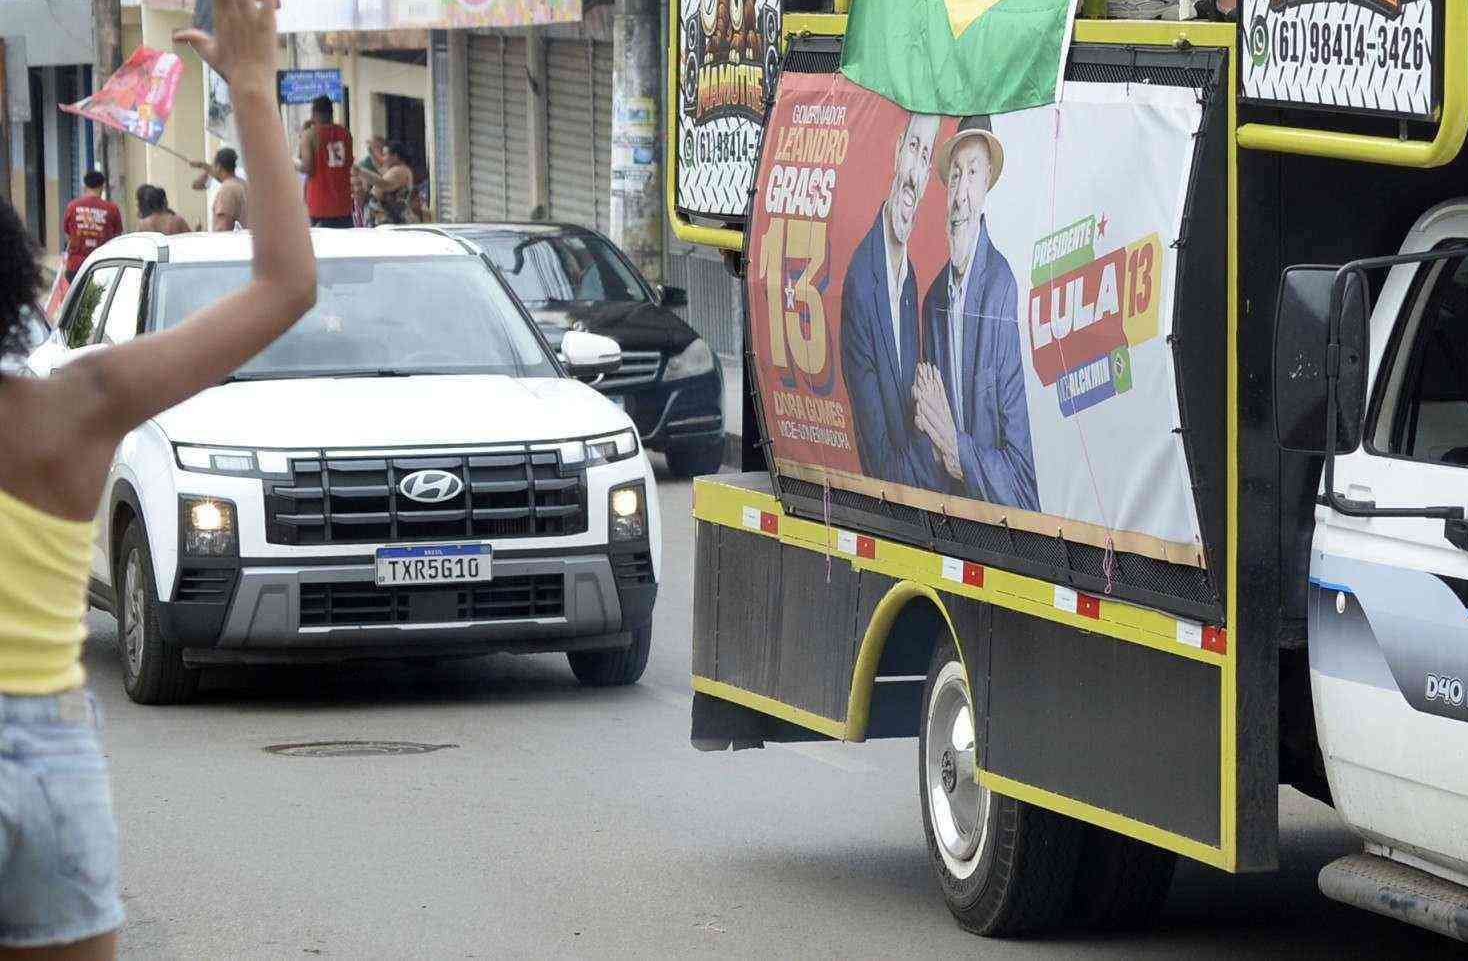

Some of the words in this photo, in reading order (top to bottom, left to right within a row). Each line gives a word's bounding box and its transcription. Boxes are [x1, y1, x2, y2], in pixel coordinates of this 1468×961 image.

[697, 64, 766, 118] MAMUTHE
[775, 126, 849, 166] LEANDRO
[766, 164, 837, 219] GRASS
[759, 217, 836, 375] 13
[1032, 262, 1120, 350] LULA
[1127, 242, 1155, 318] 13
[388, 557, 480, 582] TXR5G10
[1425, 674, 1464, 705] D40
